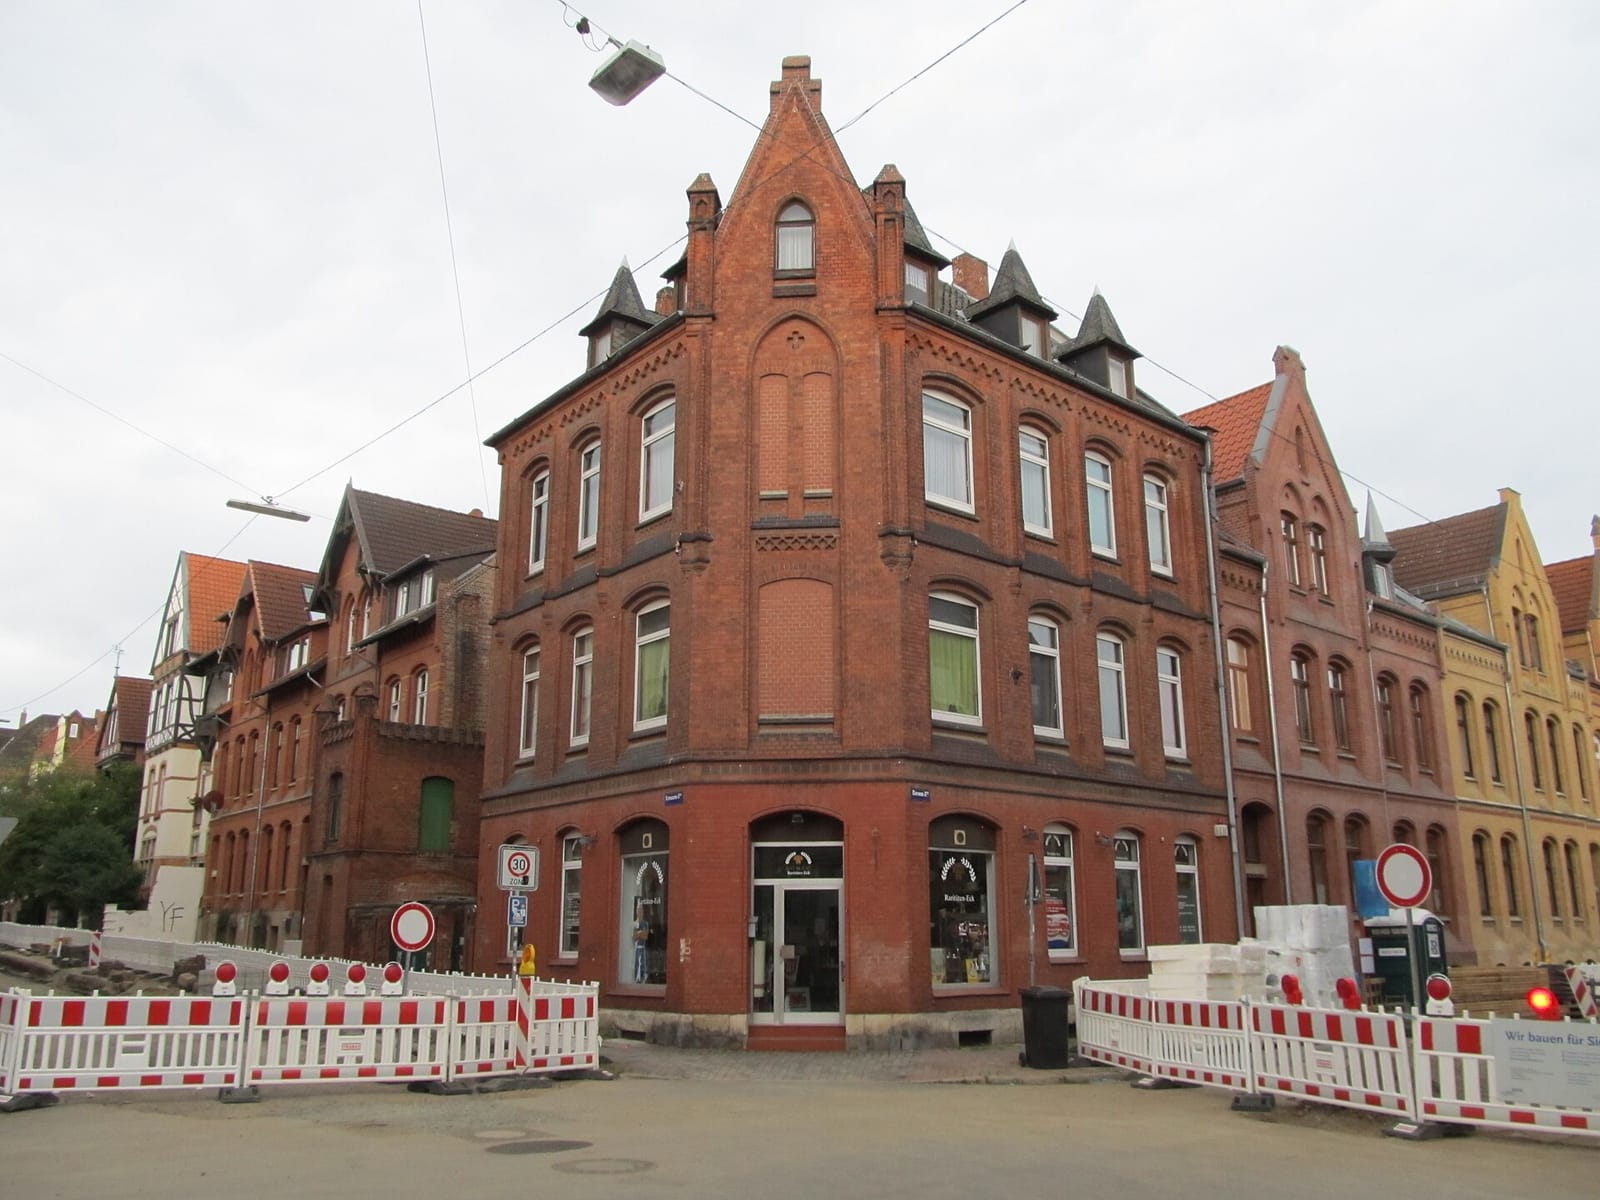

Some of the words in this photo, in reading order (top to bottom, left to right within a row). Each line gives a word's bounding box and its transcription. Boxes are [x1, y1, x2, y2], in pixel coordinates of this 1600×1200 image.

[512, 859, 526, 871] 30
[511, 898, 520, 913] P
[1505, 1031, 1525, 1041] Wir
[1528, 1032, 1564, 1044] bauen
[1567, 1034, 1583, 1045] für
